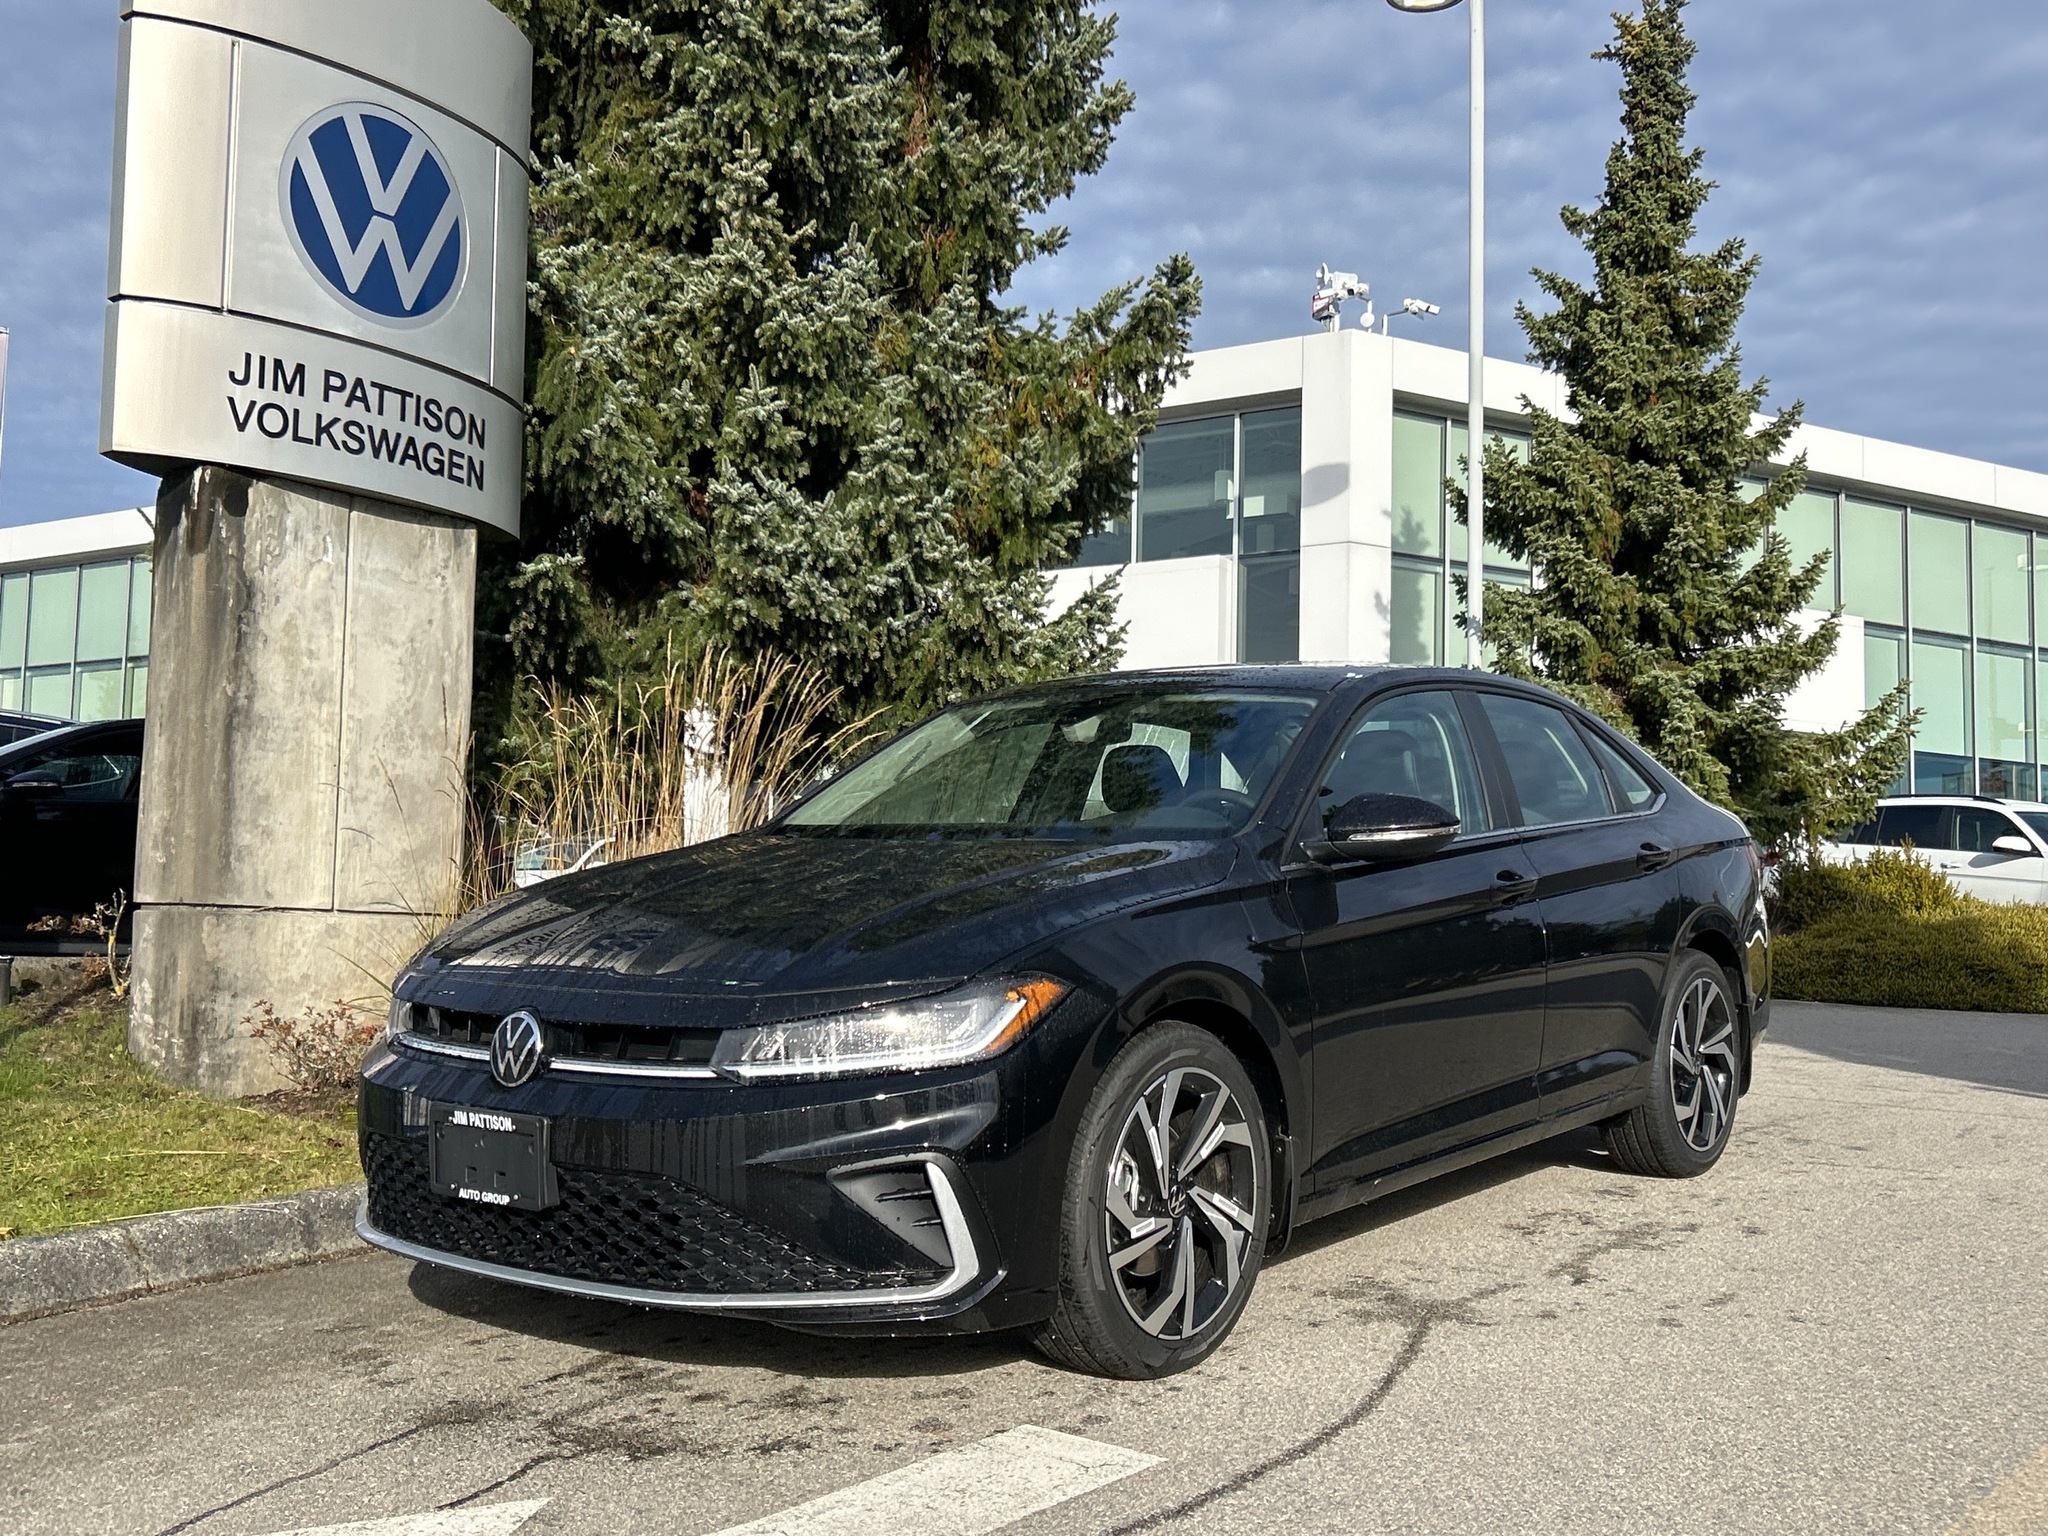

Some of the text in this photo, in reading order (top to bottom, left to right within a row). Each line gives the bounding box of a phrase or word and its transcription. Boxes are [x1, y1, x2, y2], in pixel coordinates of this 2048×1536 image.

[288, 110, 462, 315] VW
[228, 352, 486, 450] JIM PATTISON
[226, 396, 485, 492] VOLKSWAGEN
[492, 1012, 540, 1085] VW
[452, 1110, 512, 1132] JIM PATTISON
[459, 1187, 510, 1205] AUTO GROUP
